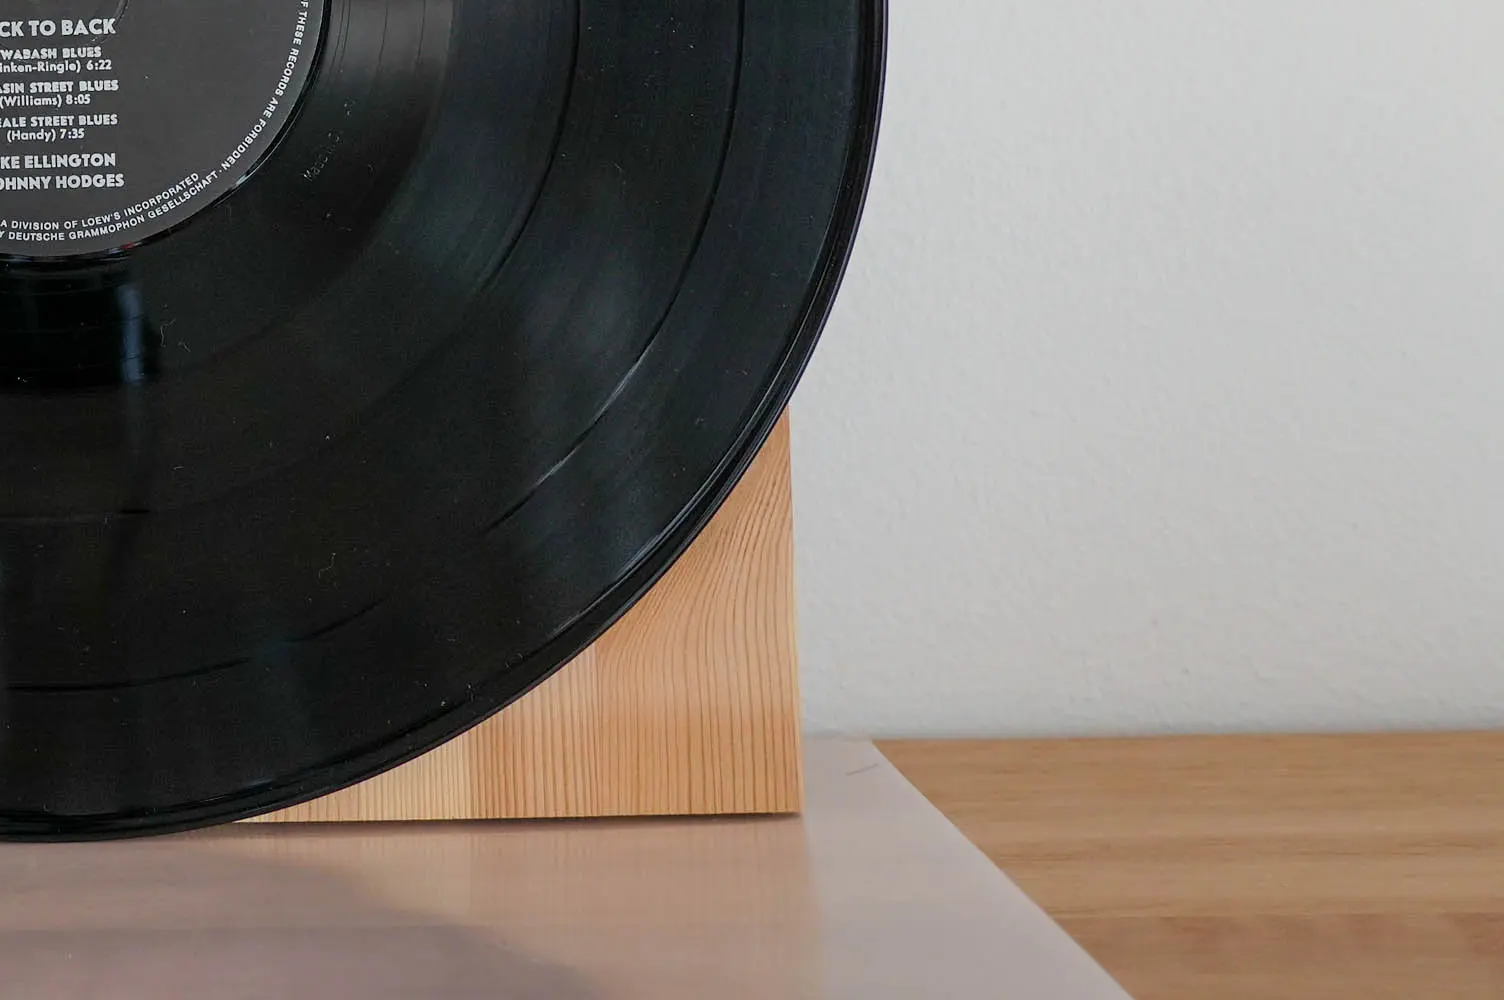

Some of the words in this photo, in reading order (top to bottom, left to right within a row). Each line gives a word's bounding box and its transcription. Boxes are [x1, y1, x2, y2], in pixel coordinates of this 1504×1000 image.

[28, 20, 56, 37] TO
[61, 17, 117, 36] BACK
[292, 10, 308, 46] THESE
[0, 49, 58, 60] WABASH
[61, 45, 102, 59] BLUES
[86, 58, 113, 71] 6:22
[274, 47, 300, 97] RECORDS
[29, 80, 74, 94] STREET
[78, 79, 120, 92] BLUES
[0, 94, 62, 109] (Williams)
[65, 93, 91, 105] 8:05
[262, 96, 279, 119] ARE
[30, 115, 75, 128] STREET
[78, 113, 118, 126] BLUES
[6, 130, 56, 142] (Handy)
[59, 127, 85, 140] 7:35
[220, 118, 267, 171] FORBIDDEN
[24, 152, 116, 169] ELLINGTON
[55, 173, 125, 189] HODGES
[0, 219, 8, 228] A
[11, 220, 60, 231] DIVISION
[63, 220, 78, 230] OF
[81, 211, 121, 228] LOEW'S
[123, 172, 199, 217] INCORPORATED
[8, 231, 65, 242] DEUTSCHE
[68, 214, 145, 240] GRAMMOPHON
[147, 170, 218, 219] GESELLSCHAFT
